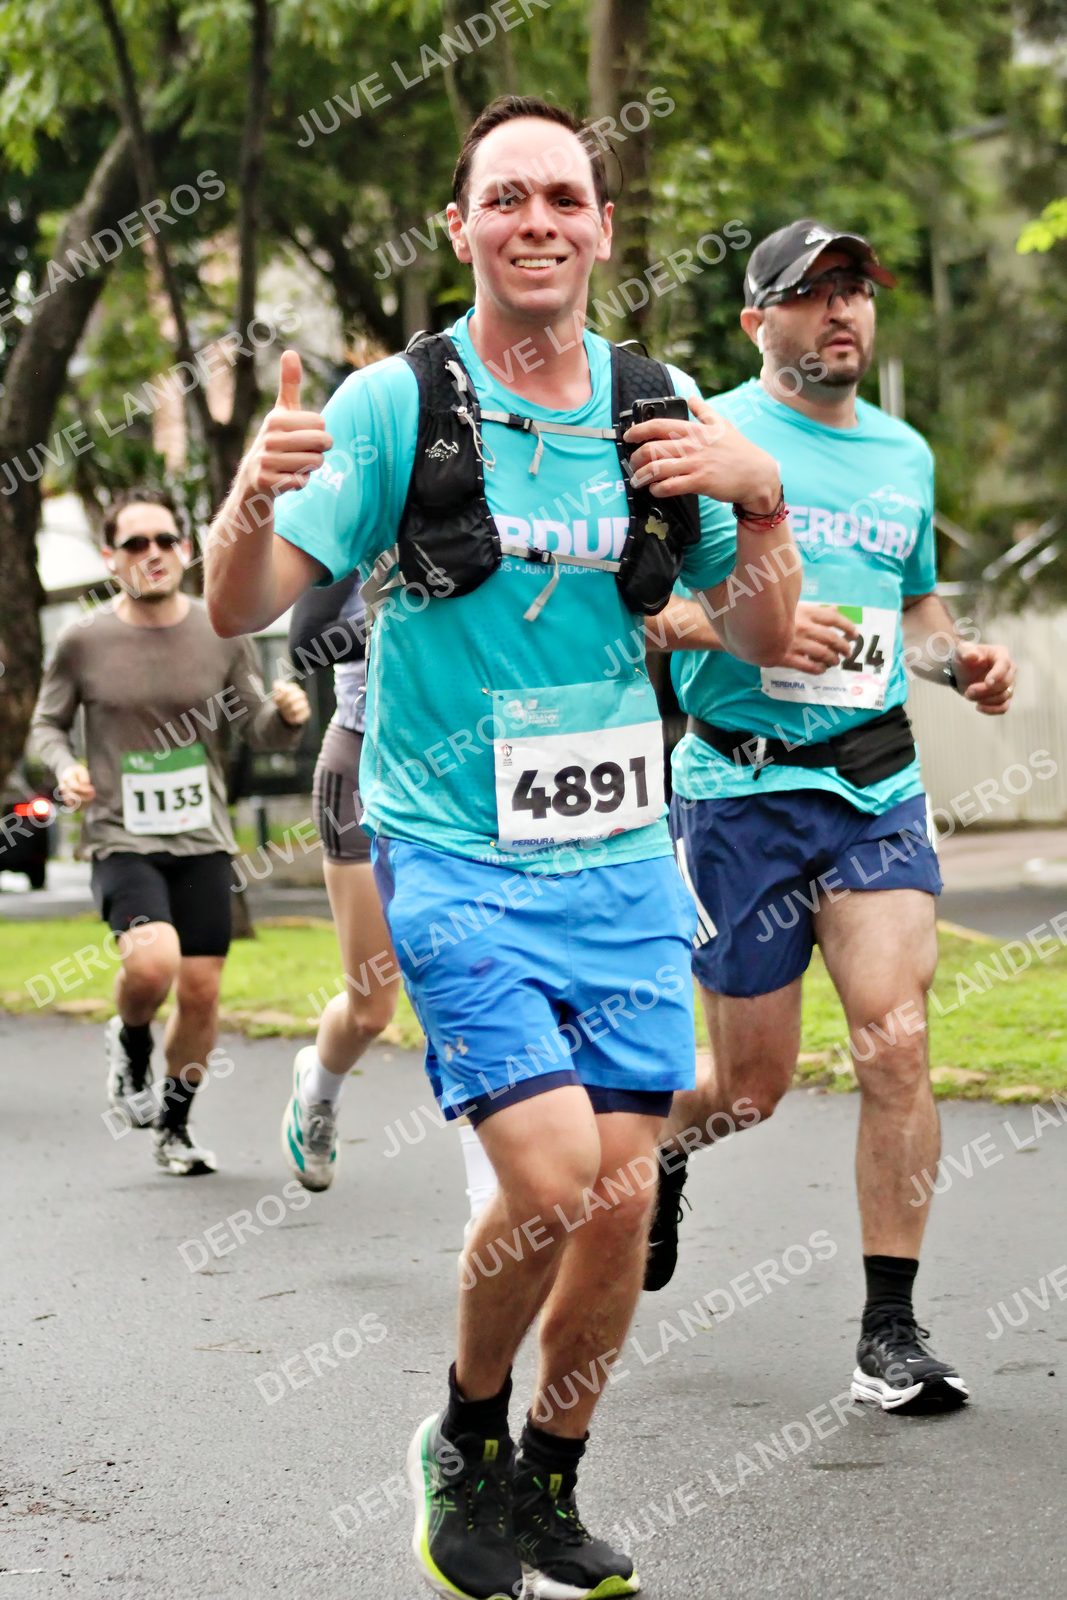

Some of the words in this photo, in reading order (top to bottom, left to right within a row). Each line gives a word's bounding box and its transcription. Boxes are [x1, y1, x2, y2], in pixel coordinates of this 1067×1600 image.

[133, 783, 203, 813] 1133
[512, 756, 648, 820] 4891
[511, 836, 555, 848] PERDURA
